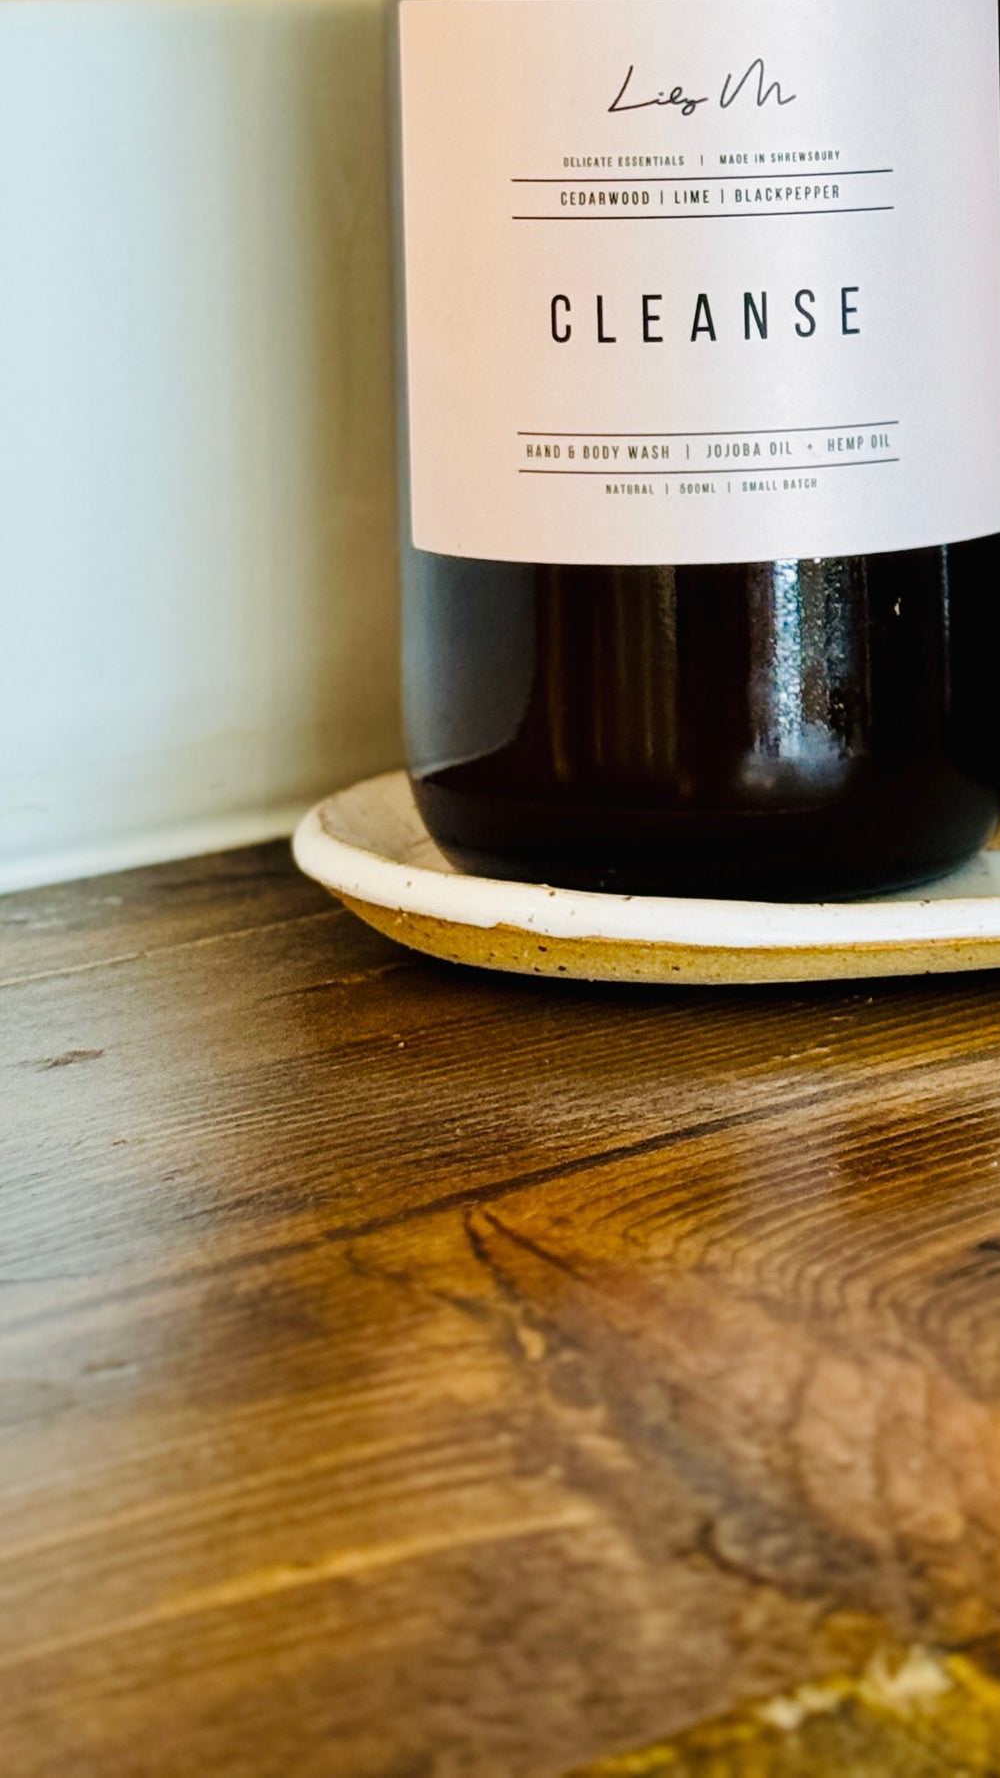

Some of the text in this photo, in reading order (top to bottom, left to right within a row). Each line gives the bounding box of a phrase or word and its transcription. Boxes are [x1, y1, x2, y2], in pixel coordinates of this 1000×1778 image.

[562, 155, 614, 168] DELICATE
[617, 155, 685, 168] ESSENTIALS
[719, 153, 749, 165] MADE
[754, 153, 766, 164] IN
[770, 150, 841, 164] SHREWSBURY
[560, 190, 650, 207] CEDARWOOD
[674, 189, 710, 205] LIME
[734, 184, 840, 204] BLACKPEPPER
[550, 286, 861, 344] CLEANSE
[526, 443, 561, 460] HAND
[567, 444, 576, 460] &
[582, 444, 620, 460] BODY
[627, 444, 670, 460] WASH
[705, 441, 762, 459] JOJOBA
[769, 440, 793, 457] OIL
[827, 435, 864, 453] HEMP
[870, 433, 891, 450] OIL
[605, 483, 655, 496] NATURAL
[679, 482, 717, 495] 500ML
[741, 479, 778, 493] SMALL
[782, 477, 818, 491] BATCH
